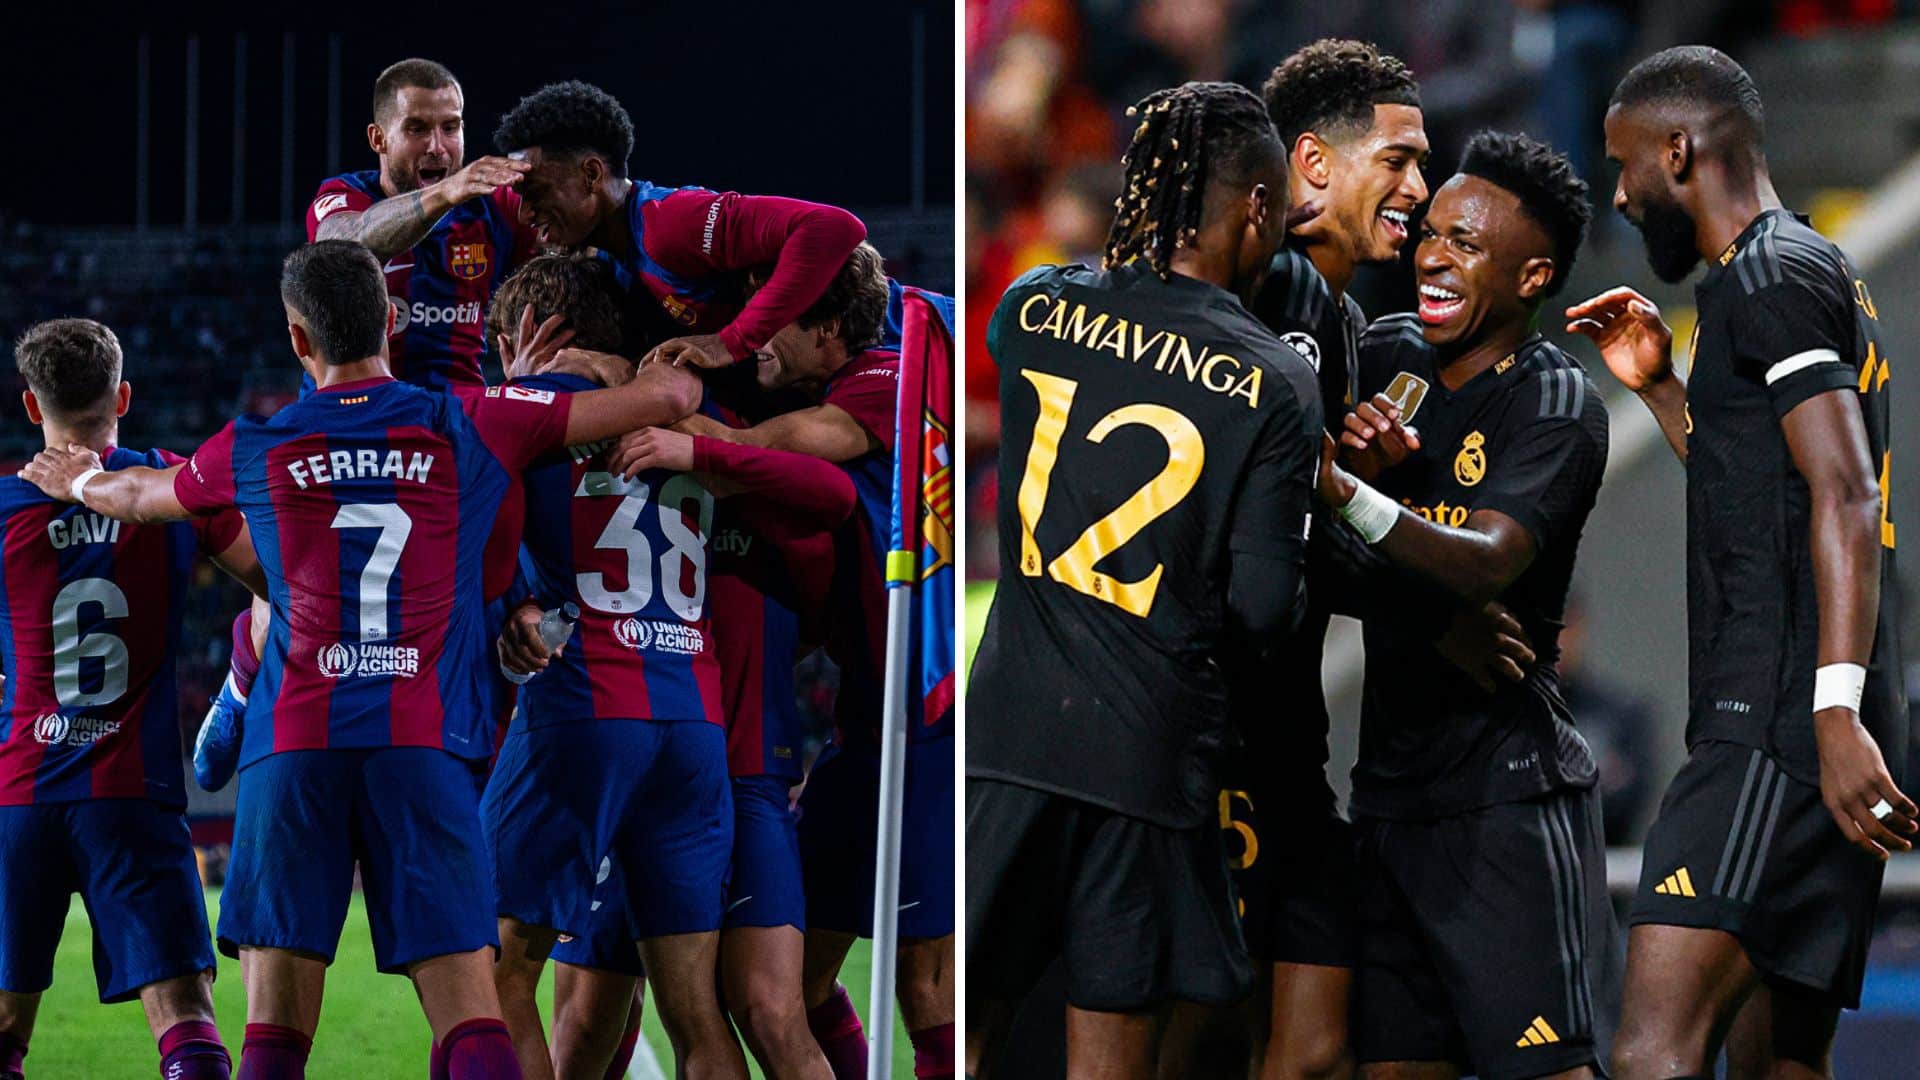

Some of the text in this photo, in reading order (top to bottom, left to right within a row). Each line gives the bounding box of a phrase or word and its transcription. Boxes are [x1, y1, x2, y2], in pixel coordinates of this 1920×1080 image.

[1019, 293, 1263, 409] CAMAVINGA
[287, 449, 434, 490] FERRAN
[1018, 368, 1205, 618] 12
[47, 513, 120, 549] GAVI
[574, 471, 714, 622] 38
[330, 503, 412, 642] 7
[52, 577, 129, 707] 6
[360, 644, 419, 660] UNHCR
[653, 621, 704, 639] UNHCR
[655, 632, 704, 652] ACNUR
[357, 658, 418, 673] ACNUR
[1218, 789, 1259, 869] 5
